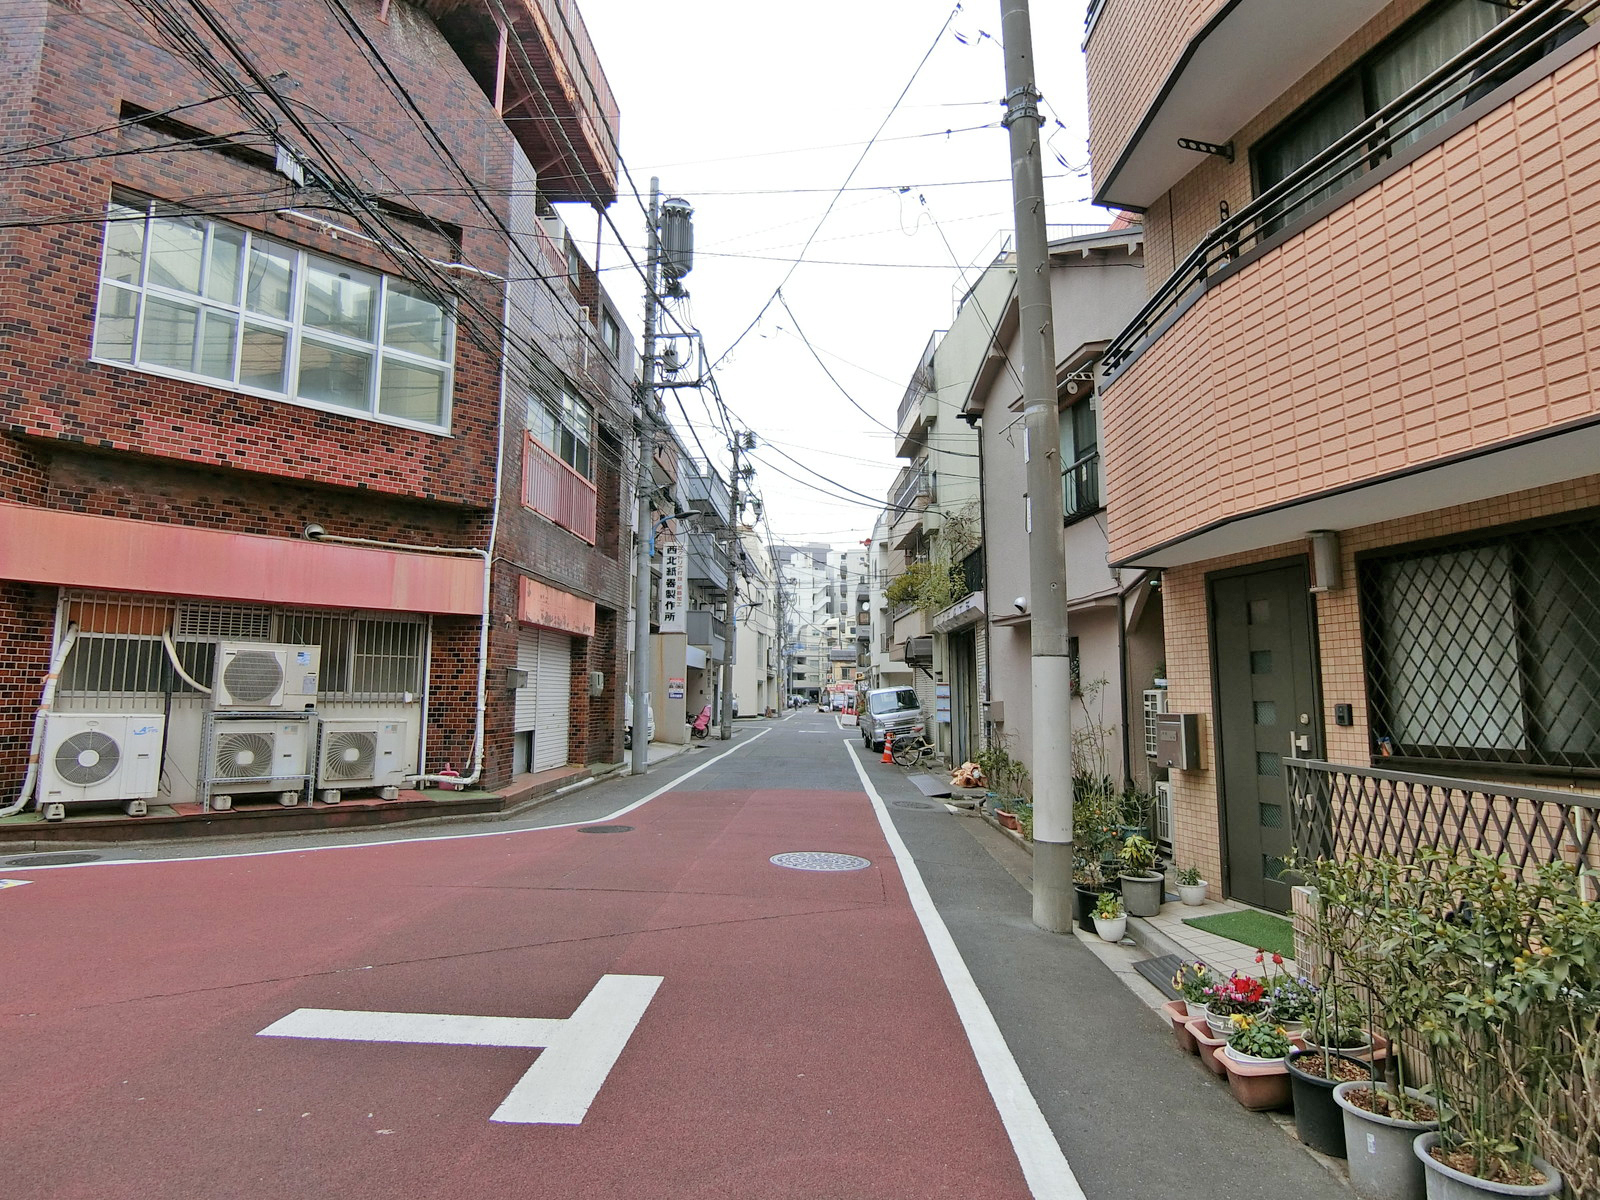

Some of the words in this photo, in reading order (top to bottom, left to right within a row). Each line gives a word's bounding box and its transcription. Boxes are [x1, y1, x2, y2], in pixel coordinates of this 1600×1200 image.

[664, 545, 678, 622] 西北紙器製作所
